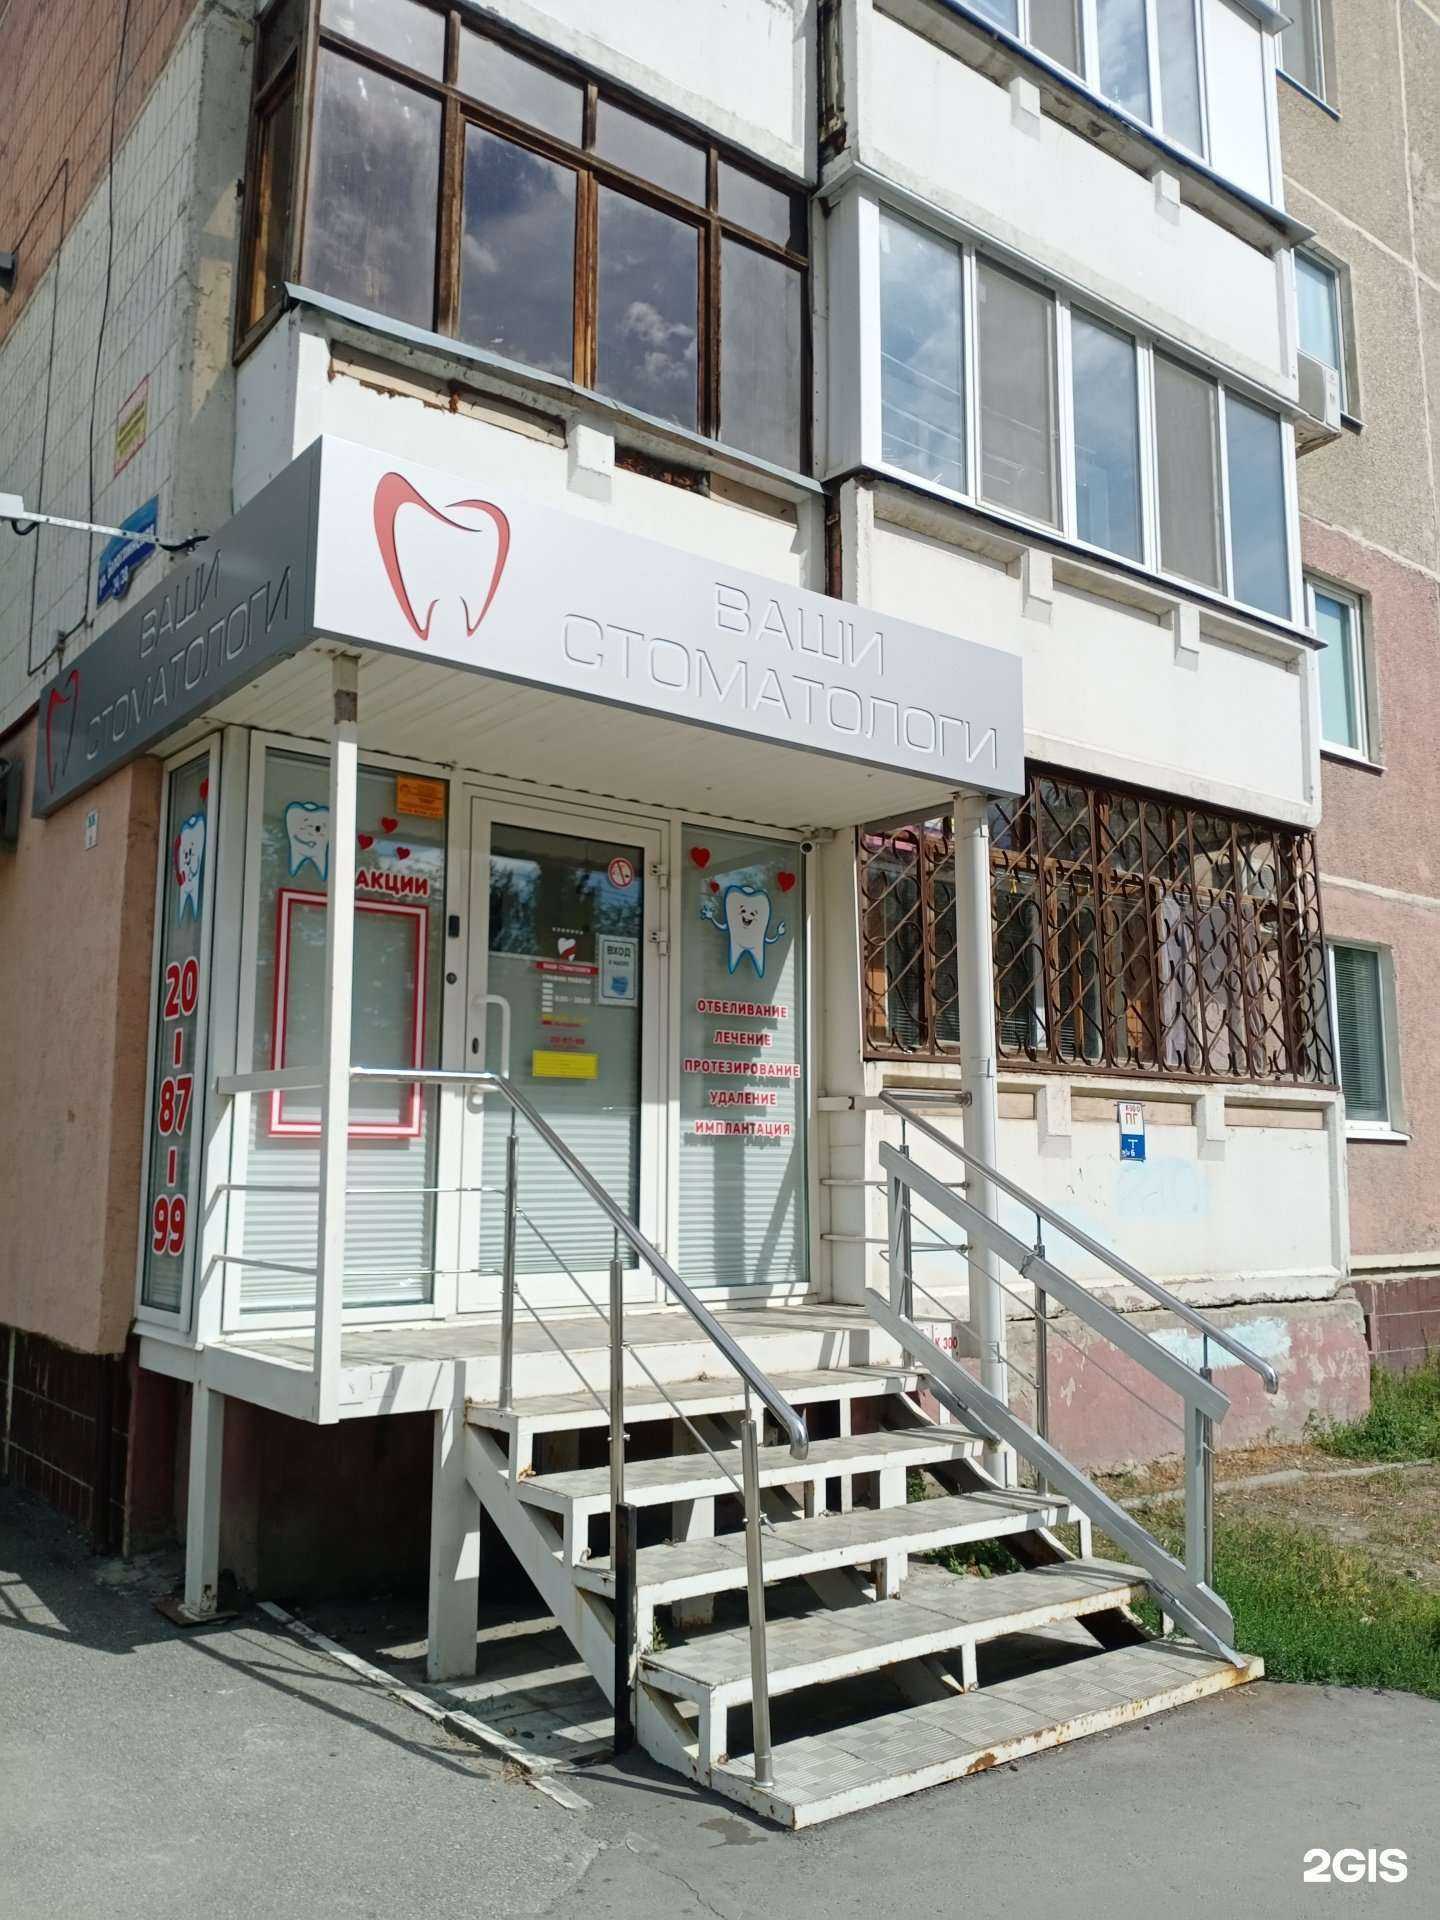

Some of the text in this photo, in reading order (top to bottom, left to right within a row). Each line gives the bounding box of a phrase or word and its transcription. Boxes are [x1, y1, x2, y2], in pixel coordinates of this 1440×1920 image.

[138, 549, 221, 659] ВАШИ
[713, 581, 885, 676] ВАШИ
[86, 565, 290, 760] СТОМАТОЛОГИ
[561, 612, 999, 770] СТОМАТОЛОГИ
[355, 868, 429, 896] АКЦИИ
[697, 999, 788, 1018] ОТБЕЛИВАНИЕ
[714, 1030, 772, 1047] ЛЕЧЕНИЕ
[683, 1059, 800, 1077] ПРОТЕЗИРОВАНИЕ
[709, 1091, 777, 1106] УДАЛЕНИЕ
[695, 1121, 791, 1137] ИМПЛАНТАЦИЯ
[153, 1196, 187, 1254] 99
